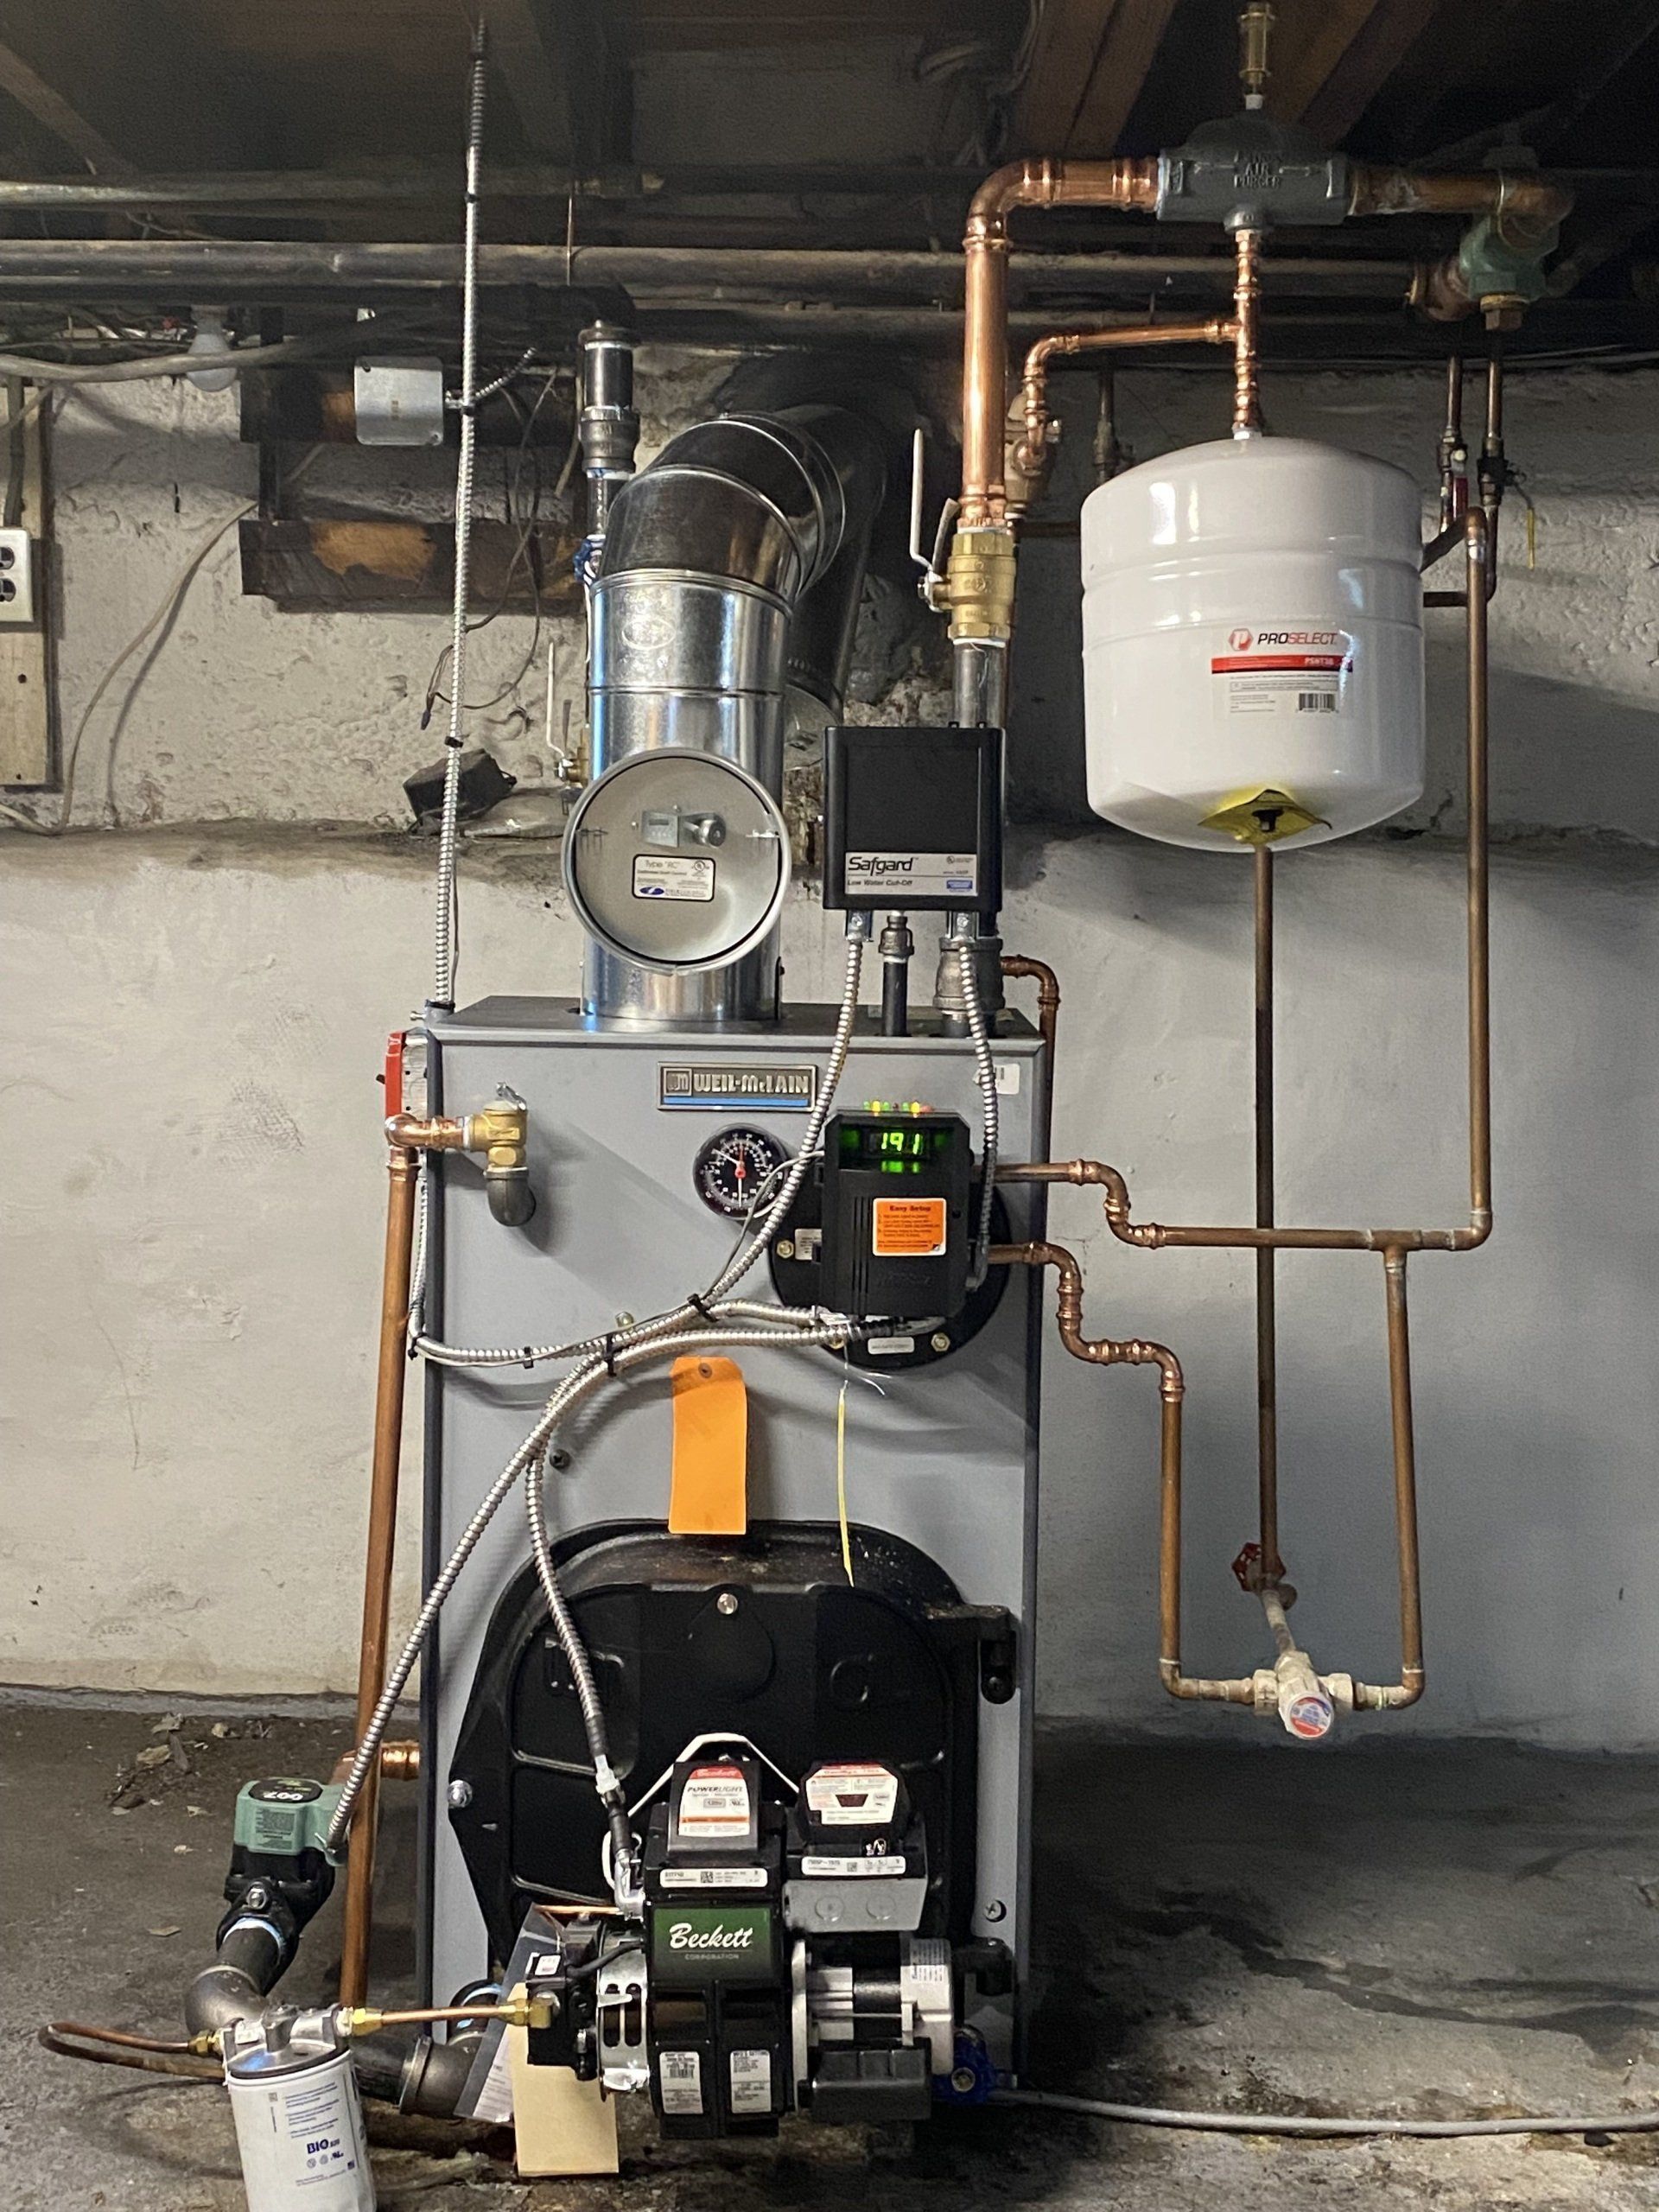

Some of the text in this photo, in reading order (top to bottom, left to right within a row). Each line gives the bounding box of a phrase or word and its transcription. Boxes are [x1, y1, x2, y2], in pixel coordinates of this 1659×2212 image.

[1257, 632, 1338, 645] PROSELECT
[848, 856, 914, 876] Safgard
[880, 1132, 920, 1154] 191
[669, 1923, 753, 1948] Beckett
[306, 2139, 329, 2154] BIO
